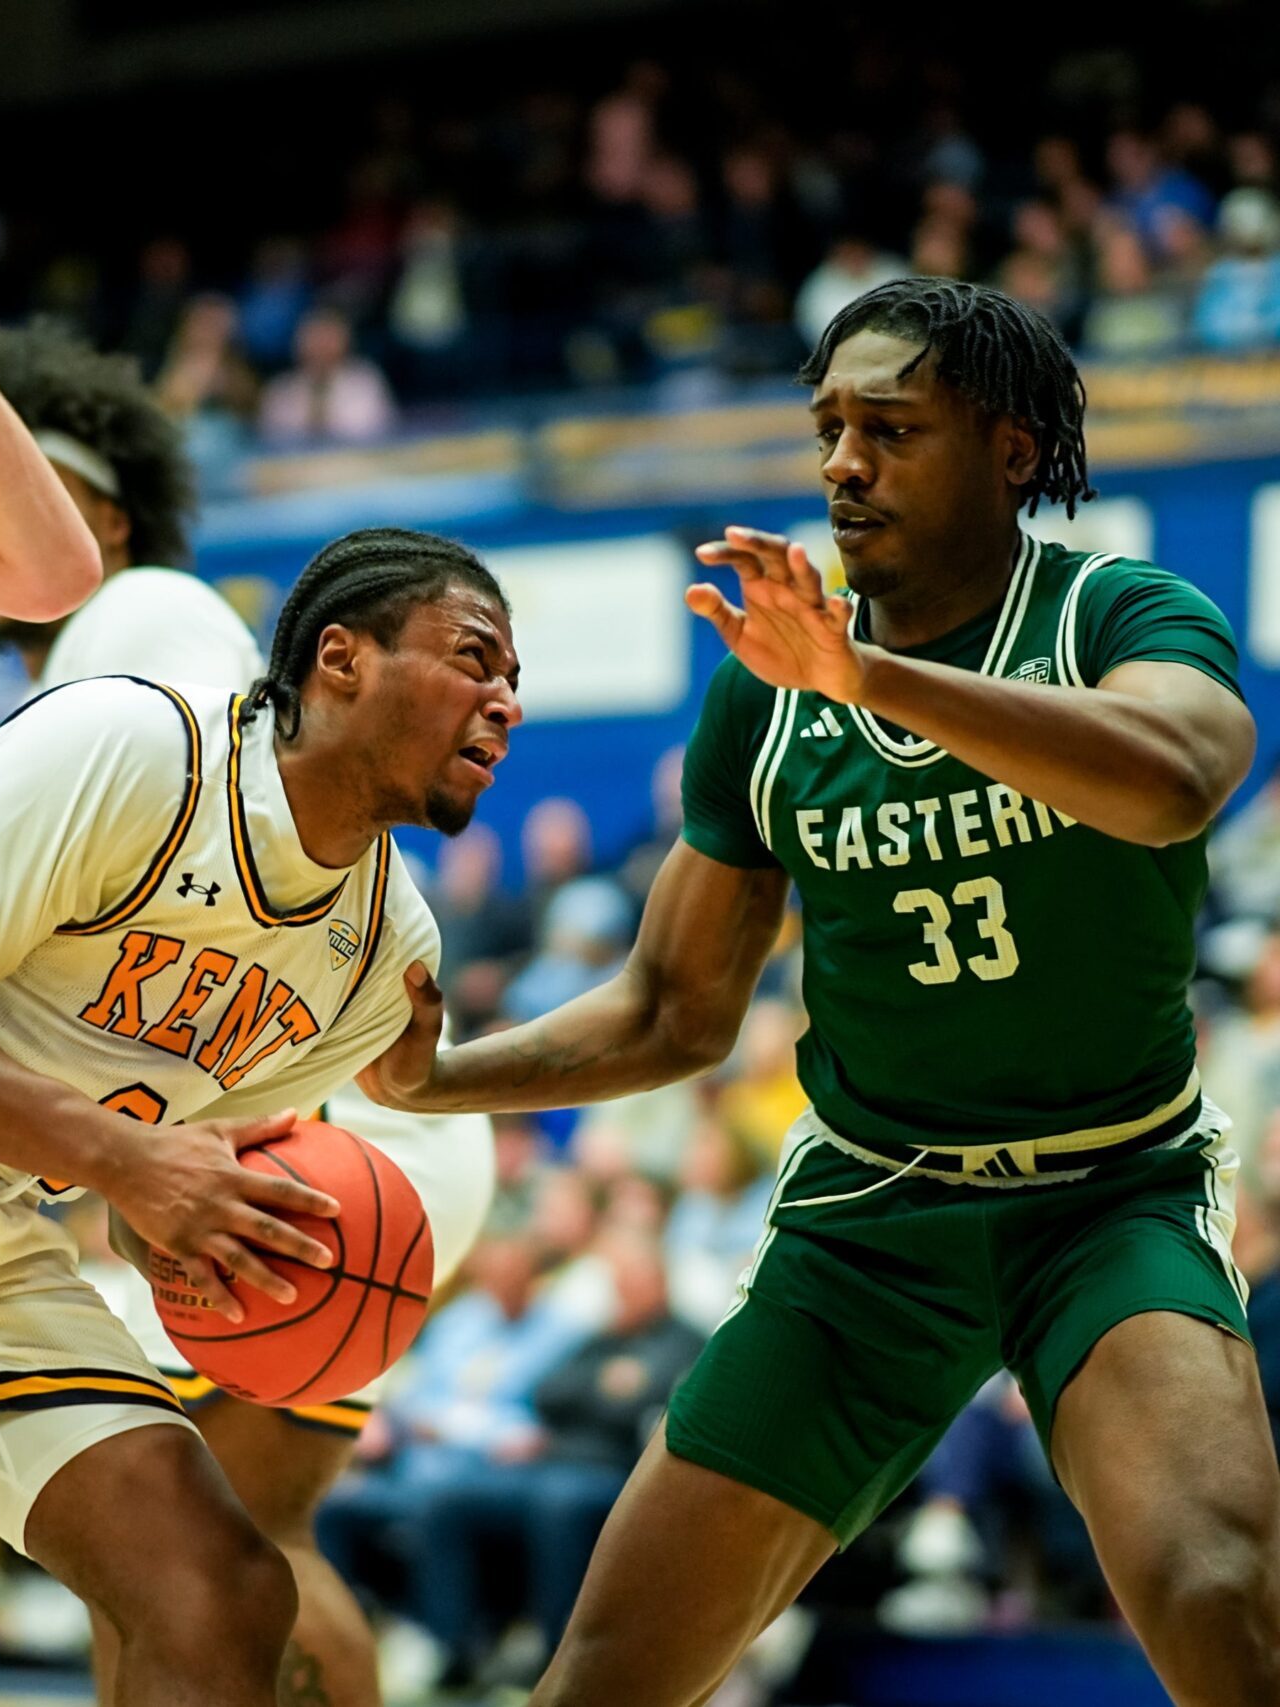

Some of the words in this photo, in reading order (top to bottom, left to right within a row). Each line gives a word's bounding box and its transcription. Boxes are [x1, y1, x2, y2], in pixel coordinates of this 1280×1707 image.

[329, 931, 357, 957] MAC
[892, 876, 1020, 985] 33
[78, 931, 320, 1091] KENT
